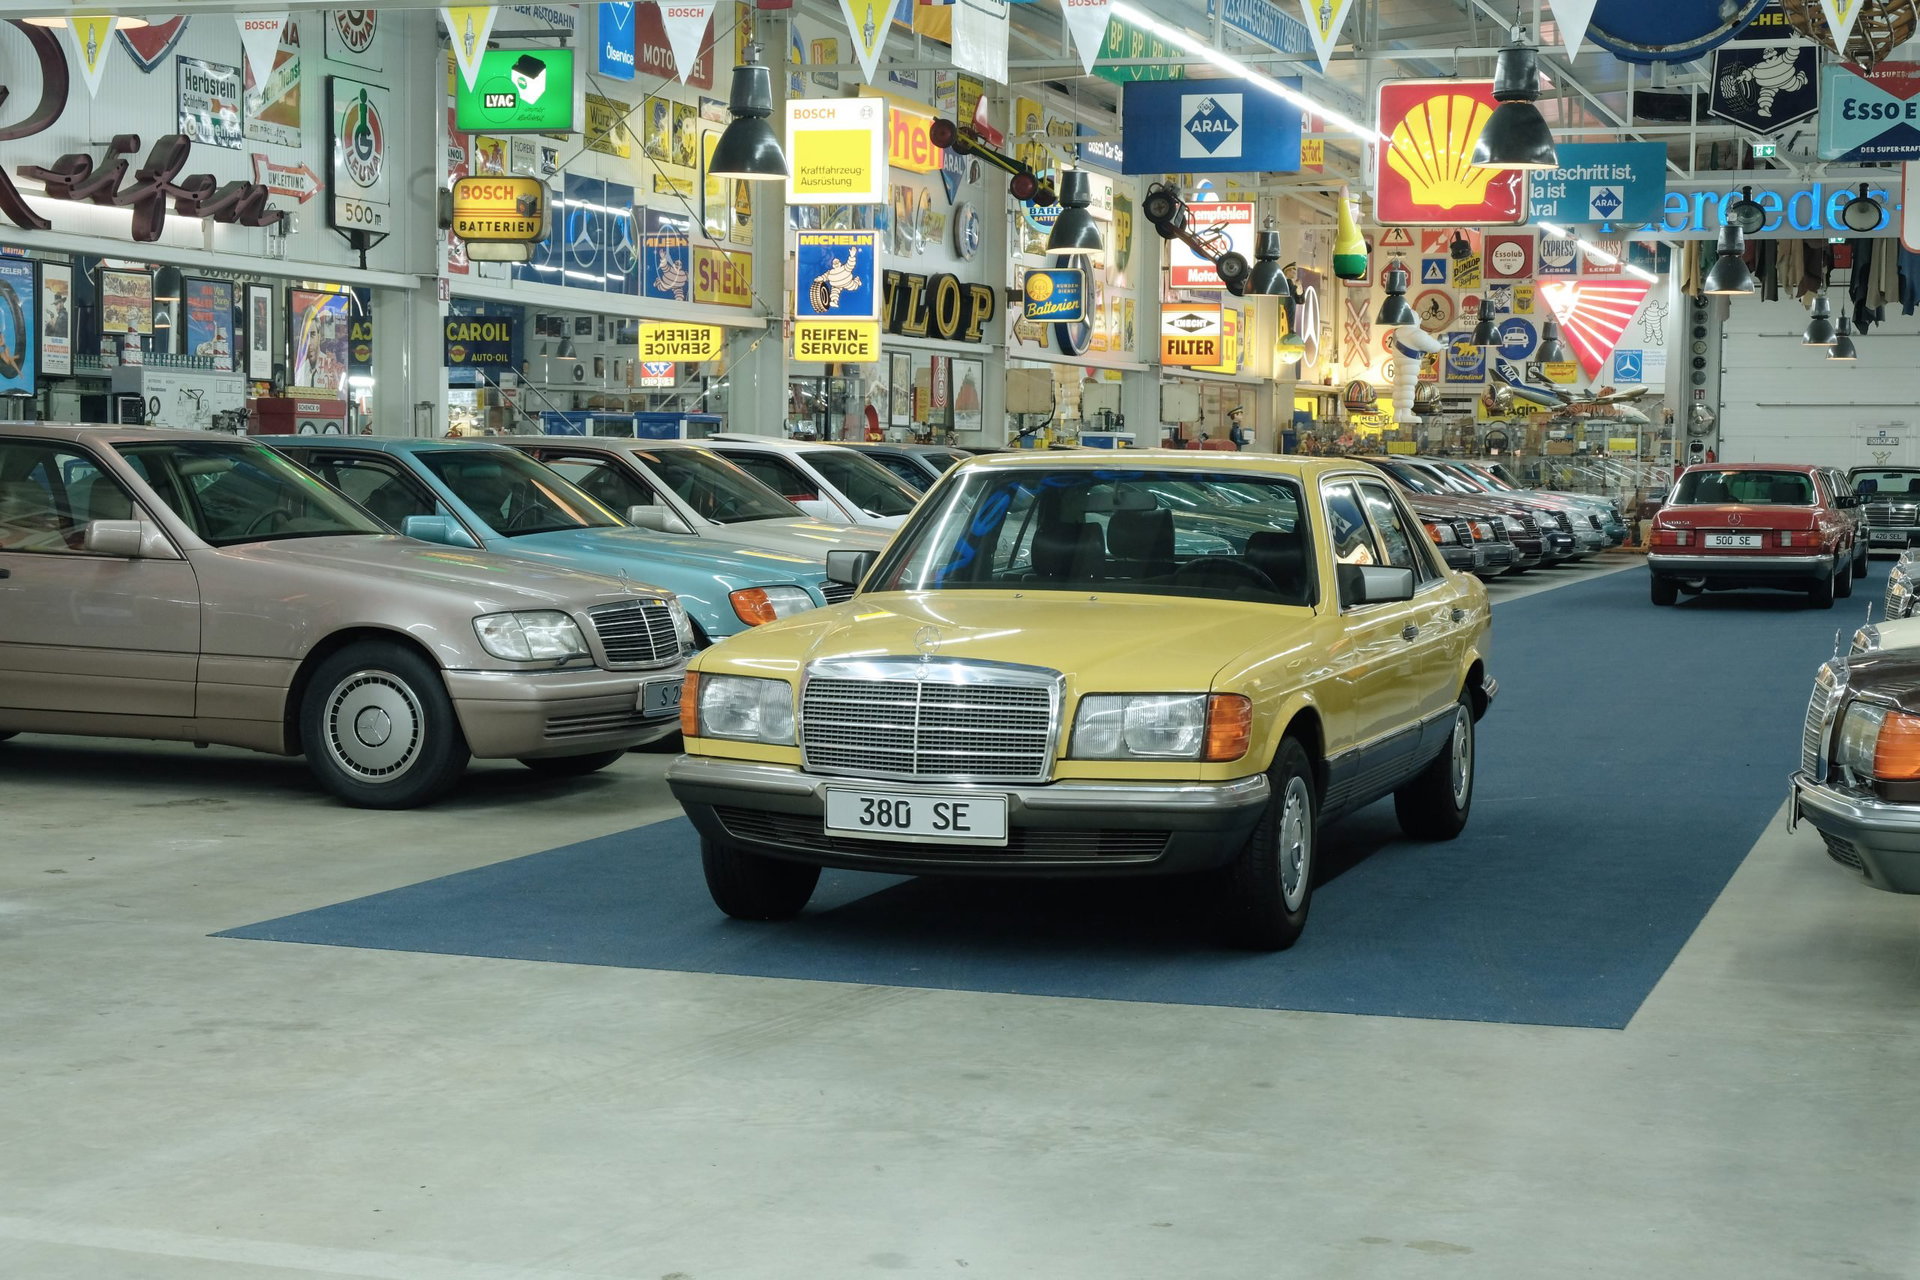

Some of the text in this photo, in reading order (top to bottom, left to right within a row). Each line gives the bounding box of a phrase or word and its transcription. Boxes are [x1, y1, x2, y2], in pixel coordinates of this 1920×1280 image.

[533, 6, 575, 30] AUTOBAHN
[668, 8, 704, 18] BOSCH
[245, 21, 278, 30] BOSCH
[337, 12, 374, 47] LEUNA
[1110, 21, 1123, 51] BP
[606, 42, 634, 65] Ölservice
[1132, 33, 1144, 58] BP
[643, 43, 677, 71] MOTO
[185, 68, 236, 99] Herbstein
[486, 95, 514, 107] LYAC
[1842, 98, 1900, 120] ESSO
[793, 108, 836, 120] BOSCH
[1190, 120, 1232, 133] ARAL
[1104, 142, 1114, 159] Car
[346, 149, 381, 182] LEUNA
[801, 166, 864, 176] Kraftfahrzeug-
[1529, 164, 1636, 182] ortschritt ist,
[801, 177, 852, 187] Ausrüstung
[460, 185, 514, 200] BOSCH
[1547, 184, 1566, 198] ist
[345, 203, 373, 224] 500
[1194, 206, 1249, 223] empfehlen
[1529, 201, 1557, 216] Aral
[460, 221, 535, 232] BATTERIEN
[800, 235, 873, 245] MICHELIN
[1543, 239, 1574, 257] EXPRESS
[0, 266, 22, 275] ZELER
[1453, 257, 1480, 277] DUNLOP
[699, 258, 748, 296] SHELL
[1026, 299, 1079, 317] Batterien
[446, 322, 510, 341] CAROIL
[801, 328, 868, 340] REIFEN-
[801, 343, 868, 355] SERVICE
[1168, 339, 1214, 355] FILTER
[471, 353, 508, 362] AUTO-OIL
[1499, 363, 1517, 382] ANA
[1507, 404, 1538, 417] Agip
[1716, 536, 1751, 545] 500 SE
[661, 686, 668, 706] S
[859, 798, 971, 831] 380 SE
